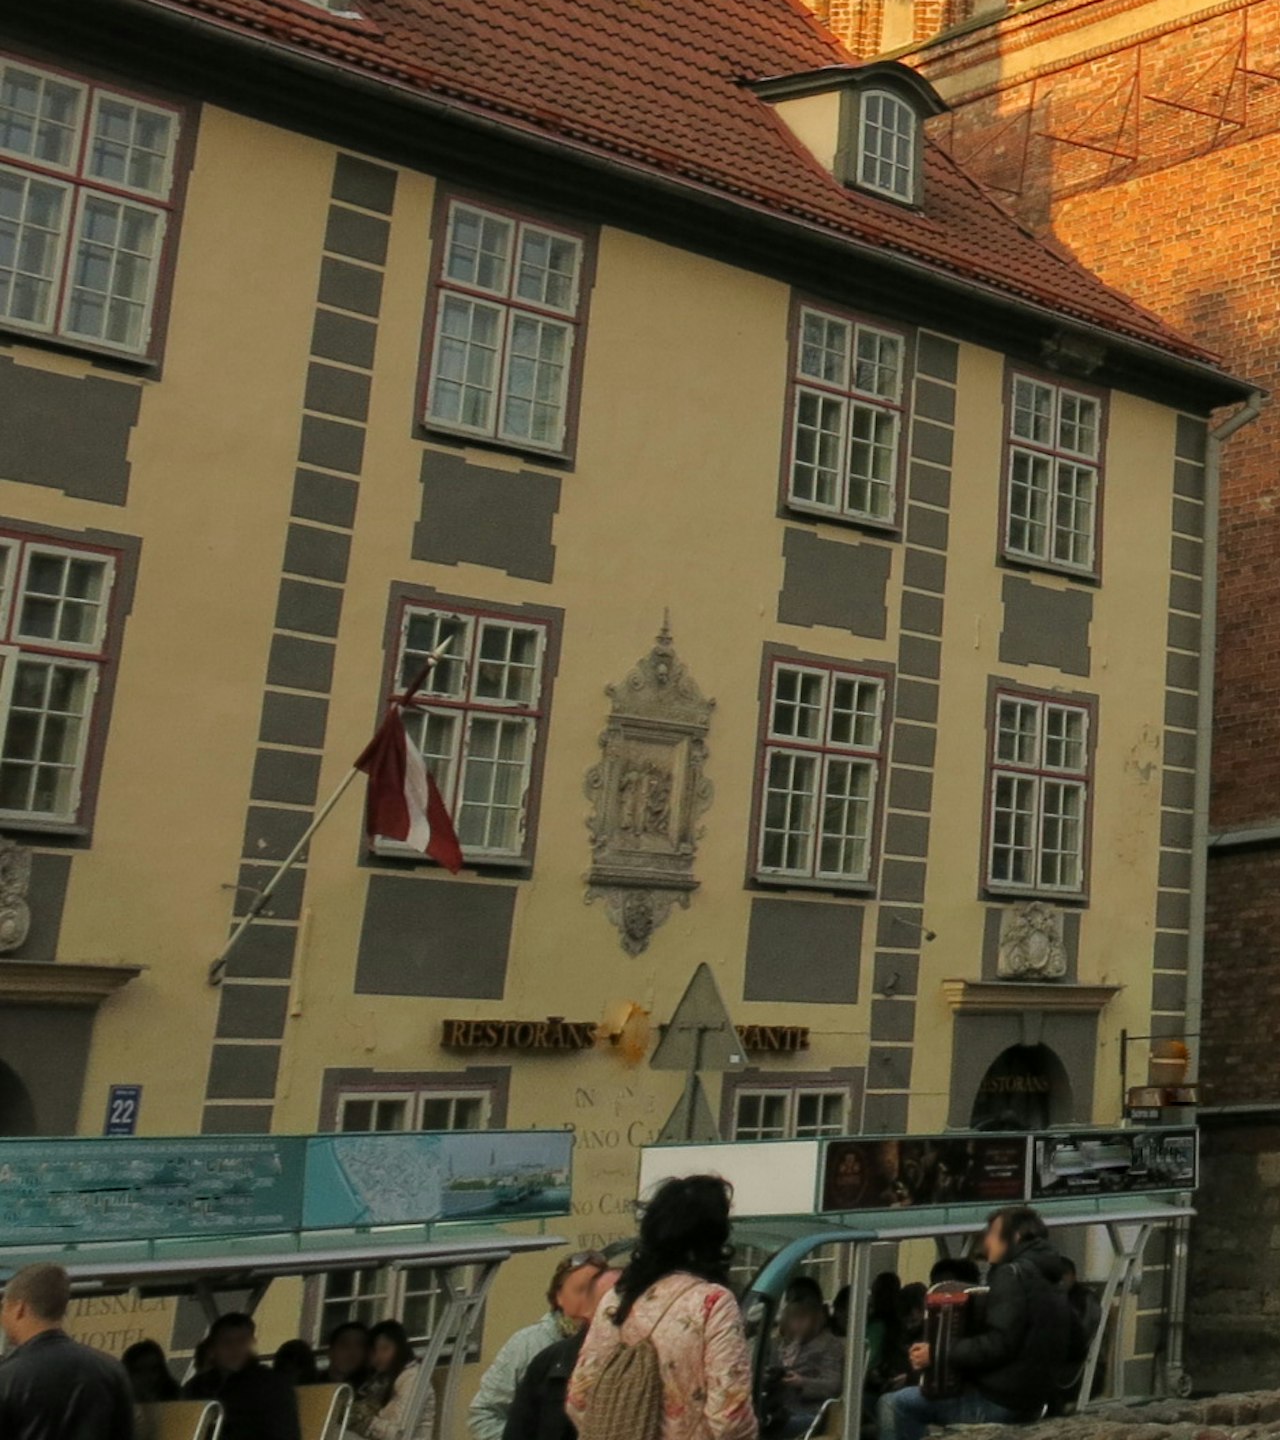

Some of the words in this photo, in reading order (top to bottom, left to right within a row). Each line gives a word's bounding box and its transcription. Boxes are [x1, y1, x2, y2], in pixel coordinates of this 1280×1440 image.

[443, 1016, 598, 1049] RESTORĀNS
[735, 1025, 811, 1051] RANTE
[111, 1099, 134, 1124] 22
